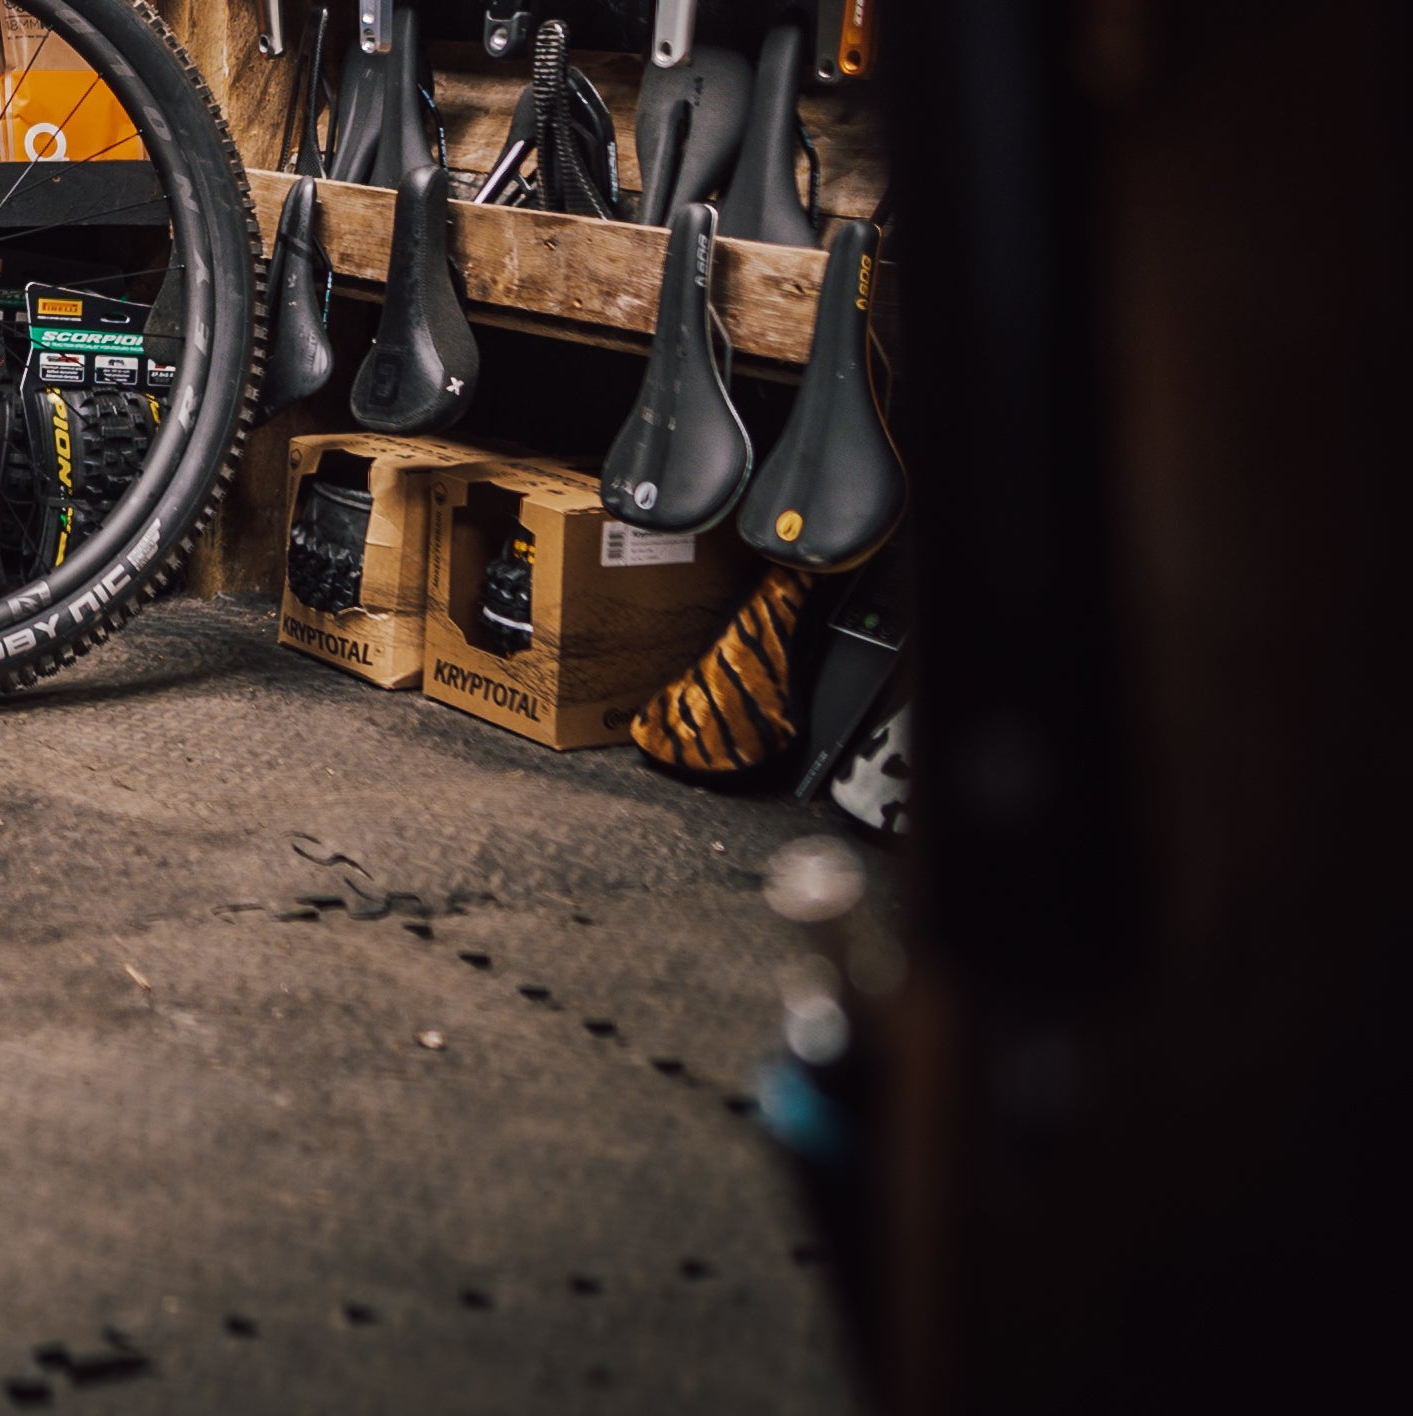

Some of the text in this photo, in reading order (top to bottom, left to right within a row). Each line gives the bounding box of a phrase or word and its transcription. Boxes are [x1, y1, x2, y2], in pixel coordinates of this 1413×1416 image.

[42, 301, 80, 313] PIRELLI
[68, 564, 131, 625] NIC
[281, 615, 373, 667] KRYPTOTAL
[433, 657, 541, 724] KRYPTOTAL
